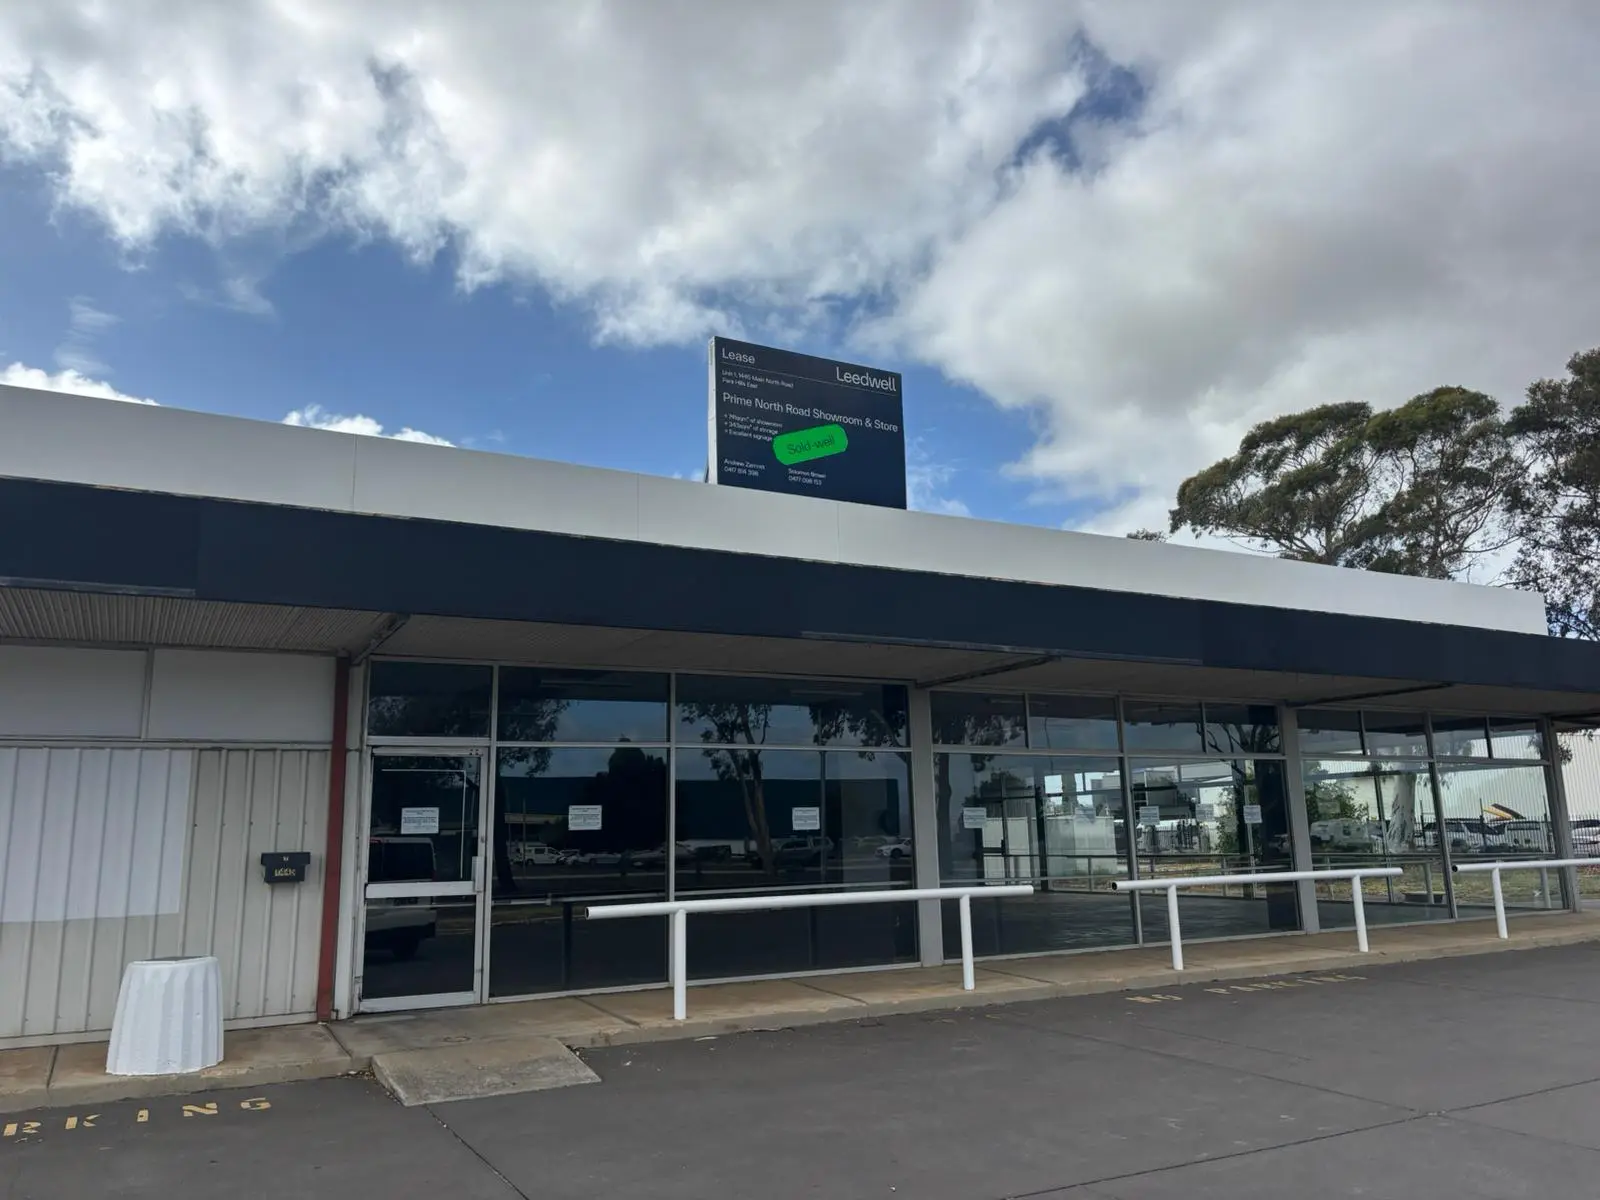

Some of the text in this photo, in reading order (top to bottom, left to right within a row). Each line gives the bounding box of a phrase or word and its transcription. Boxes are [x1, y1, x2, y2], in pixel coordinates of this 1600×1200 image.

[722, 348, 755, 364] Lease
[836, 366, 897, 392] Leedwell
[723, 392, 899, 433] Prime North Road Showroom & Store
[787, 434, 835, 455] Sold-well
